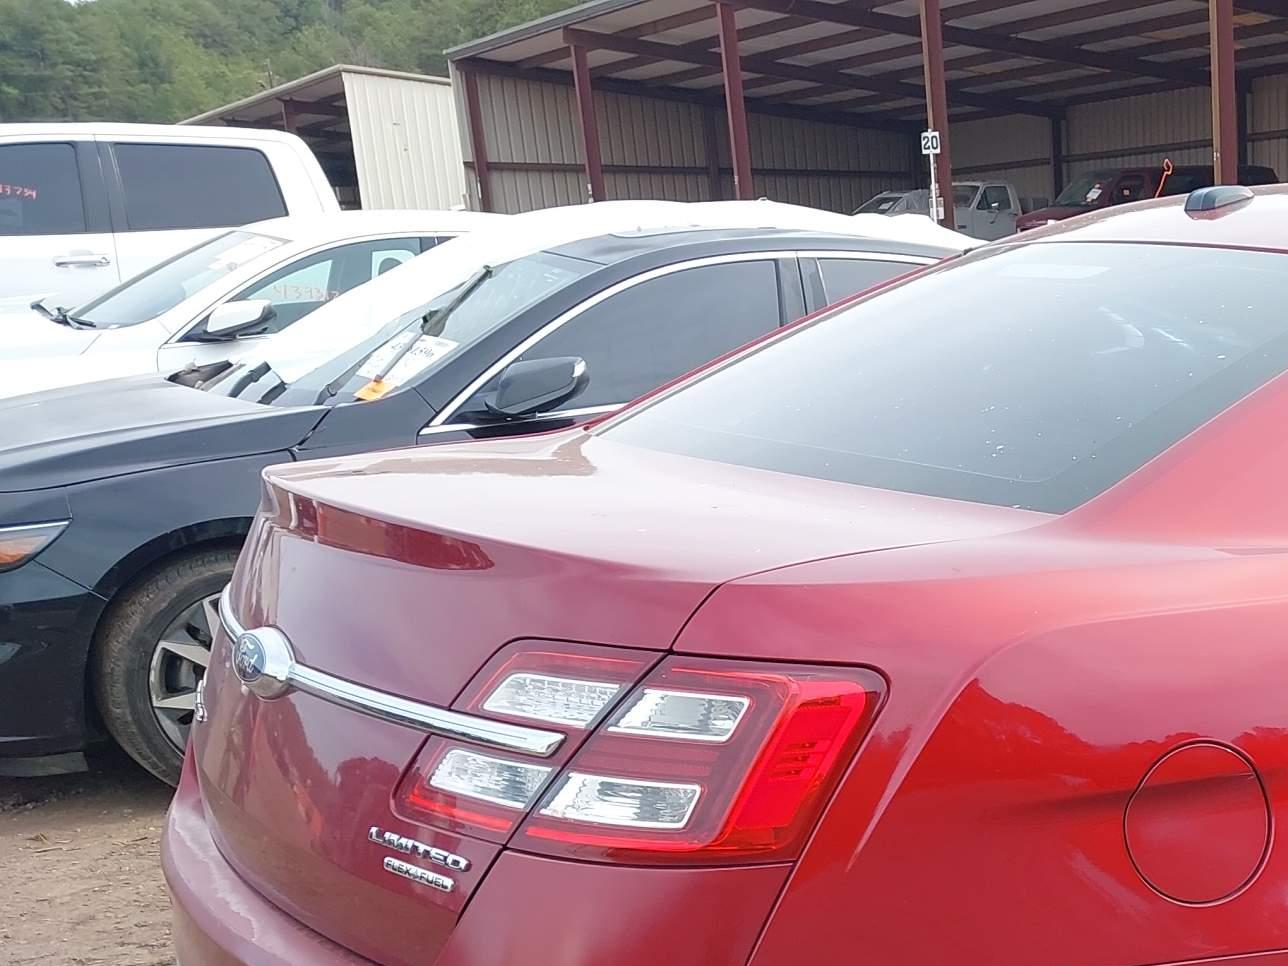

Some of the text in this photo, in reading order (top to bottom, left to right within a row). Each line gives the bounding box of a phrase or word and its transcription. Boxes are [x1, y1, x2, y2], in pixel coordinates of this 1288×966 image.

[922, 135, 939, 150] 20
[236, 638, 259, 673] Ford
[368, 826, 471, 872] LIMITED
[385, 859, 450, 890] FLEX FUEL
